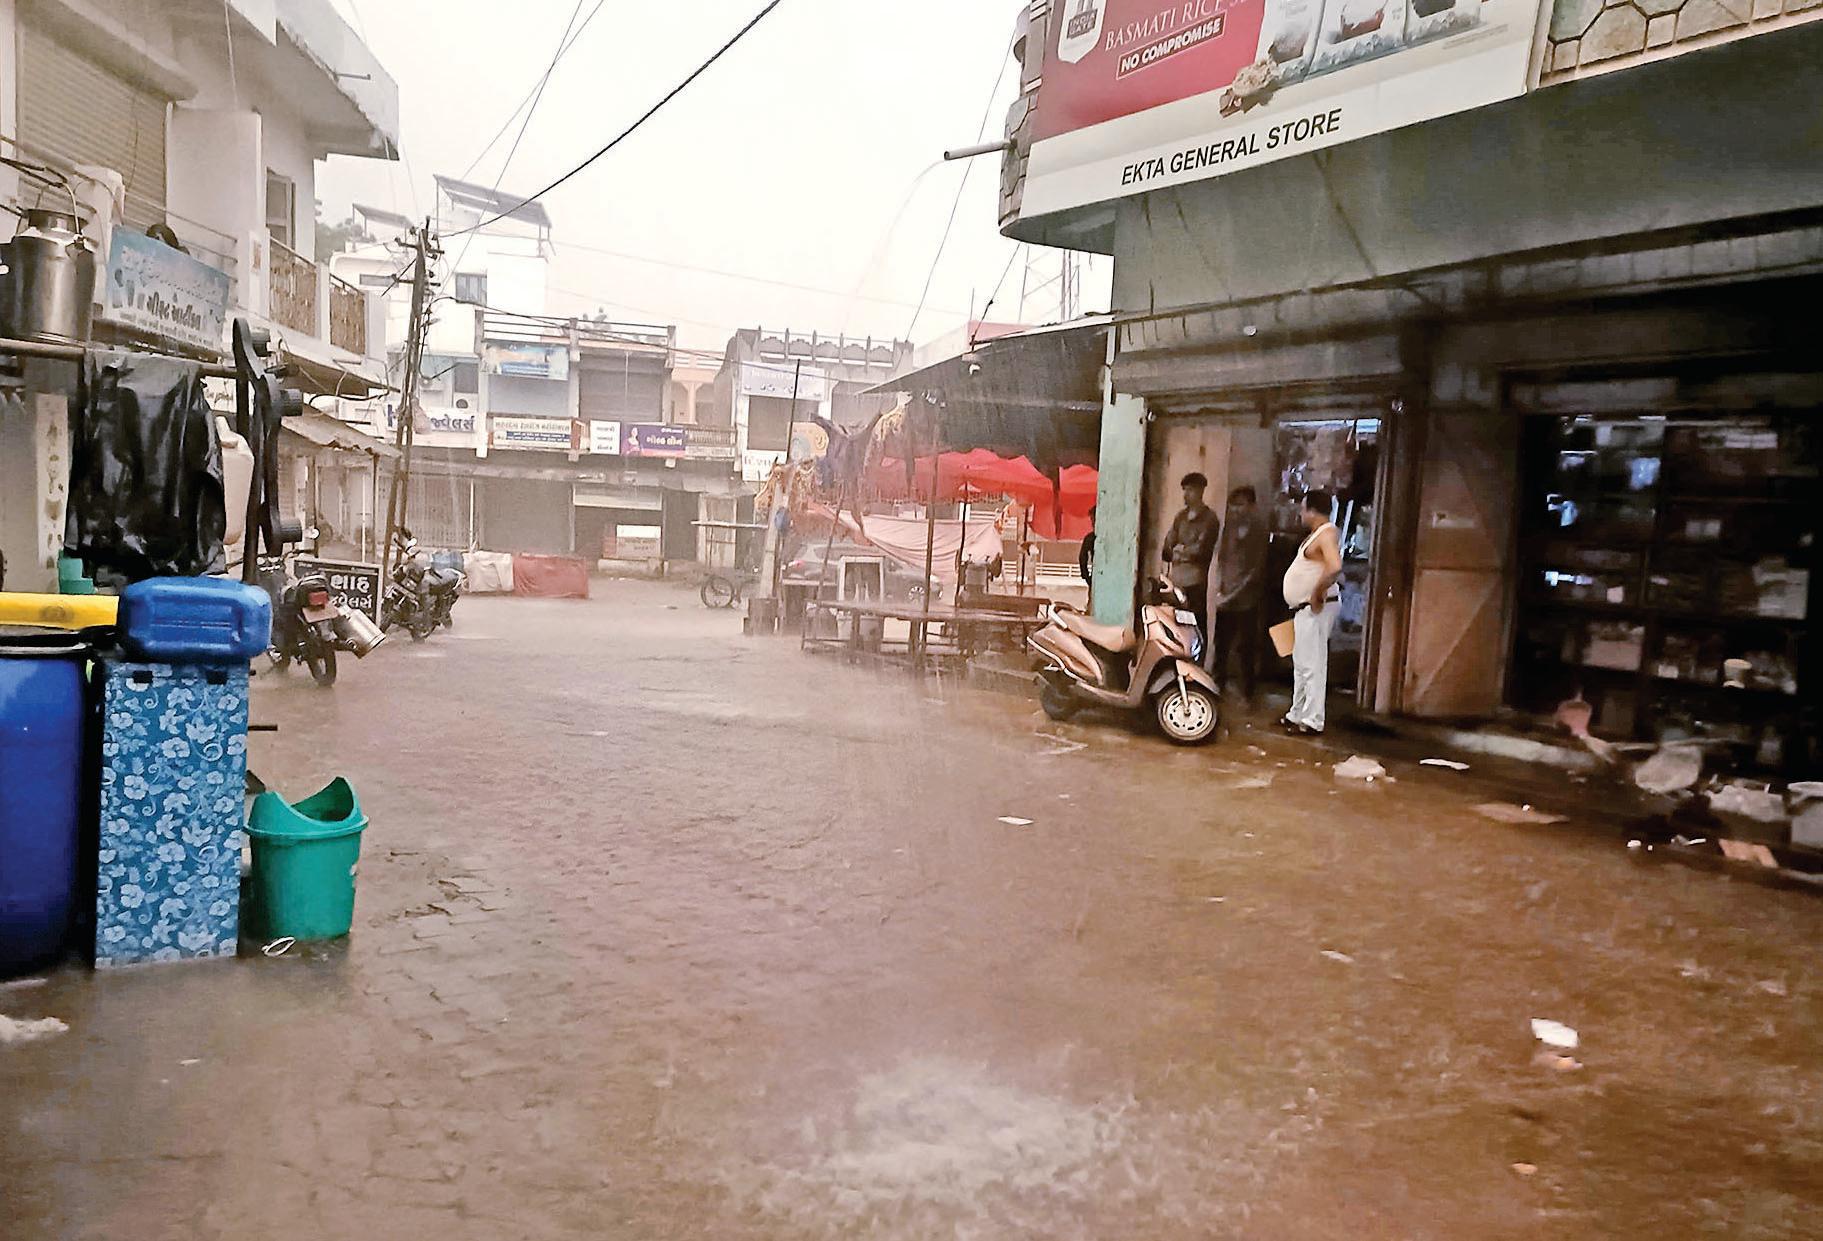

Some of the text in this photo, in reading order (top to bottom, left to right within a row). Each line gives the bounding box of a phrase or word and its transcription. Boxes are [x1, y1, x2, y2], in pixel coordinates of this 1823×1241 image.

[1069, 21, 1093, 35] GATE
[1070, 13, 1095, 27] INDIA
[1105, 8, 1176, 51] BASMATI
[1121, 18, 1221, 73] NO COMPROMISE
[1121, 108, 1342, 185] EKTA GENERAL STORE
[330, 574, 370, 593] શાહ
